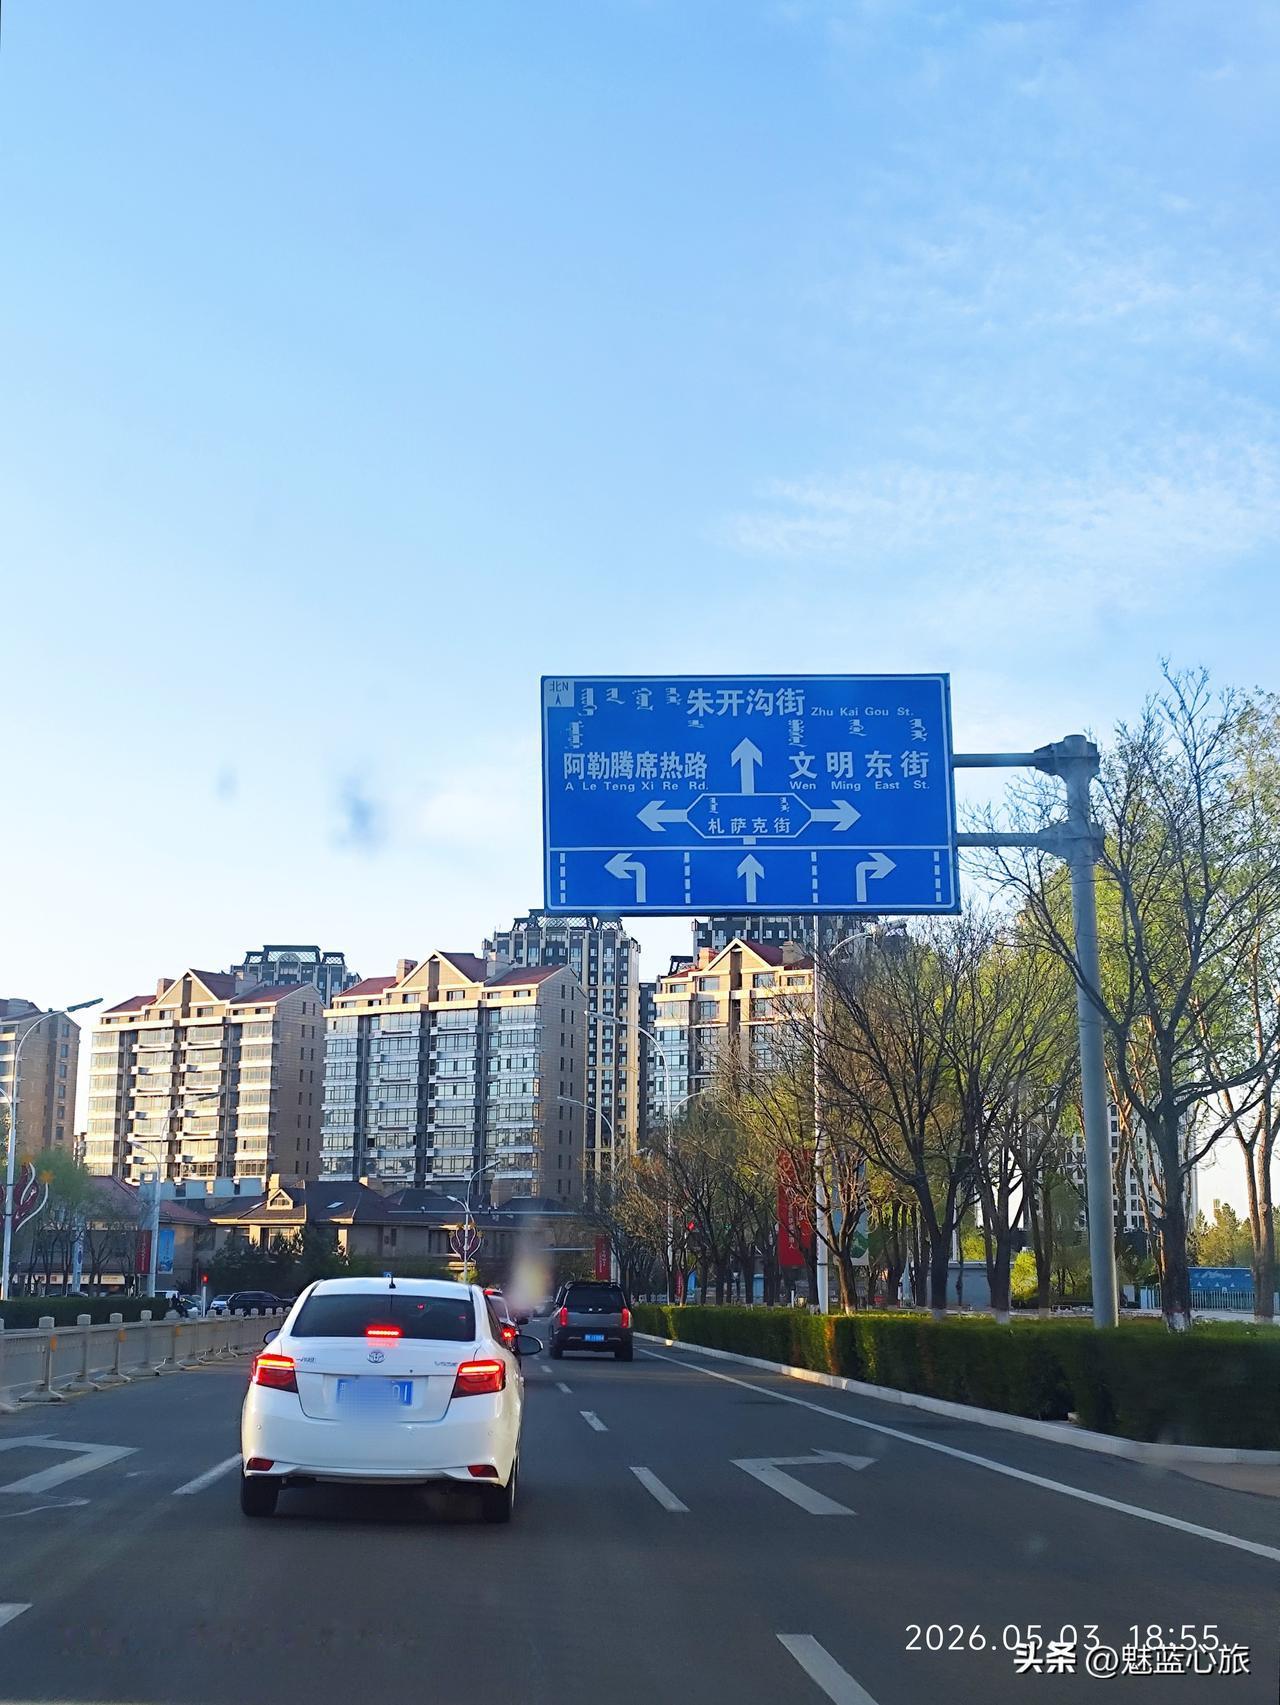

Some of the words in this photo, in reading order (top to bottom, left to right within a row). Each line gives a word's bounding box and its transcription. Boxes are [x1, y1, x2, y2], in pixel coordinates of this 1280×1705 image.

[687, 688, 805, 717] 朱开沟街
[811, 706, 834, 716] Zhu
[840, 706, 859, 716] Kai
[864, 706, 889, 716] Gou
[897, 706, 914, 716] St.
[563, 751, 708, 780] 阿勒腾席热路
[788, 750, 930, 780] 文明东街
[565, 781, 574, 791] A
[583, 781, 597, 791] Le
[604, 781, 635, 792] Teng
[641, 781, 654, 791] Xi
[663, 781, 679, 791] Re
[689, 781, 709, 791] Rd.
[789, 781, 816, 790] Wen
[831, 780, 861, 791] Ming
[875, 781, 900, 790] East
[913, 780, 930, 790] St.
[708, 817, 790, 834] 札萨克街
